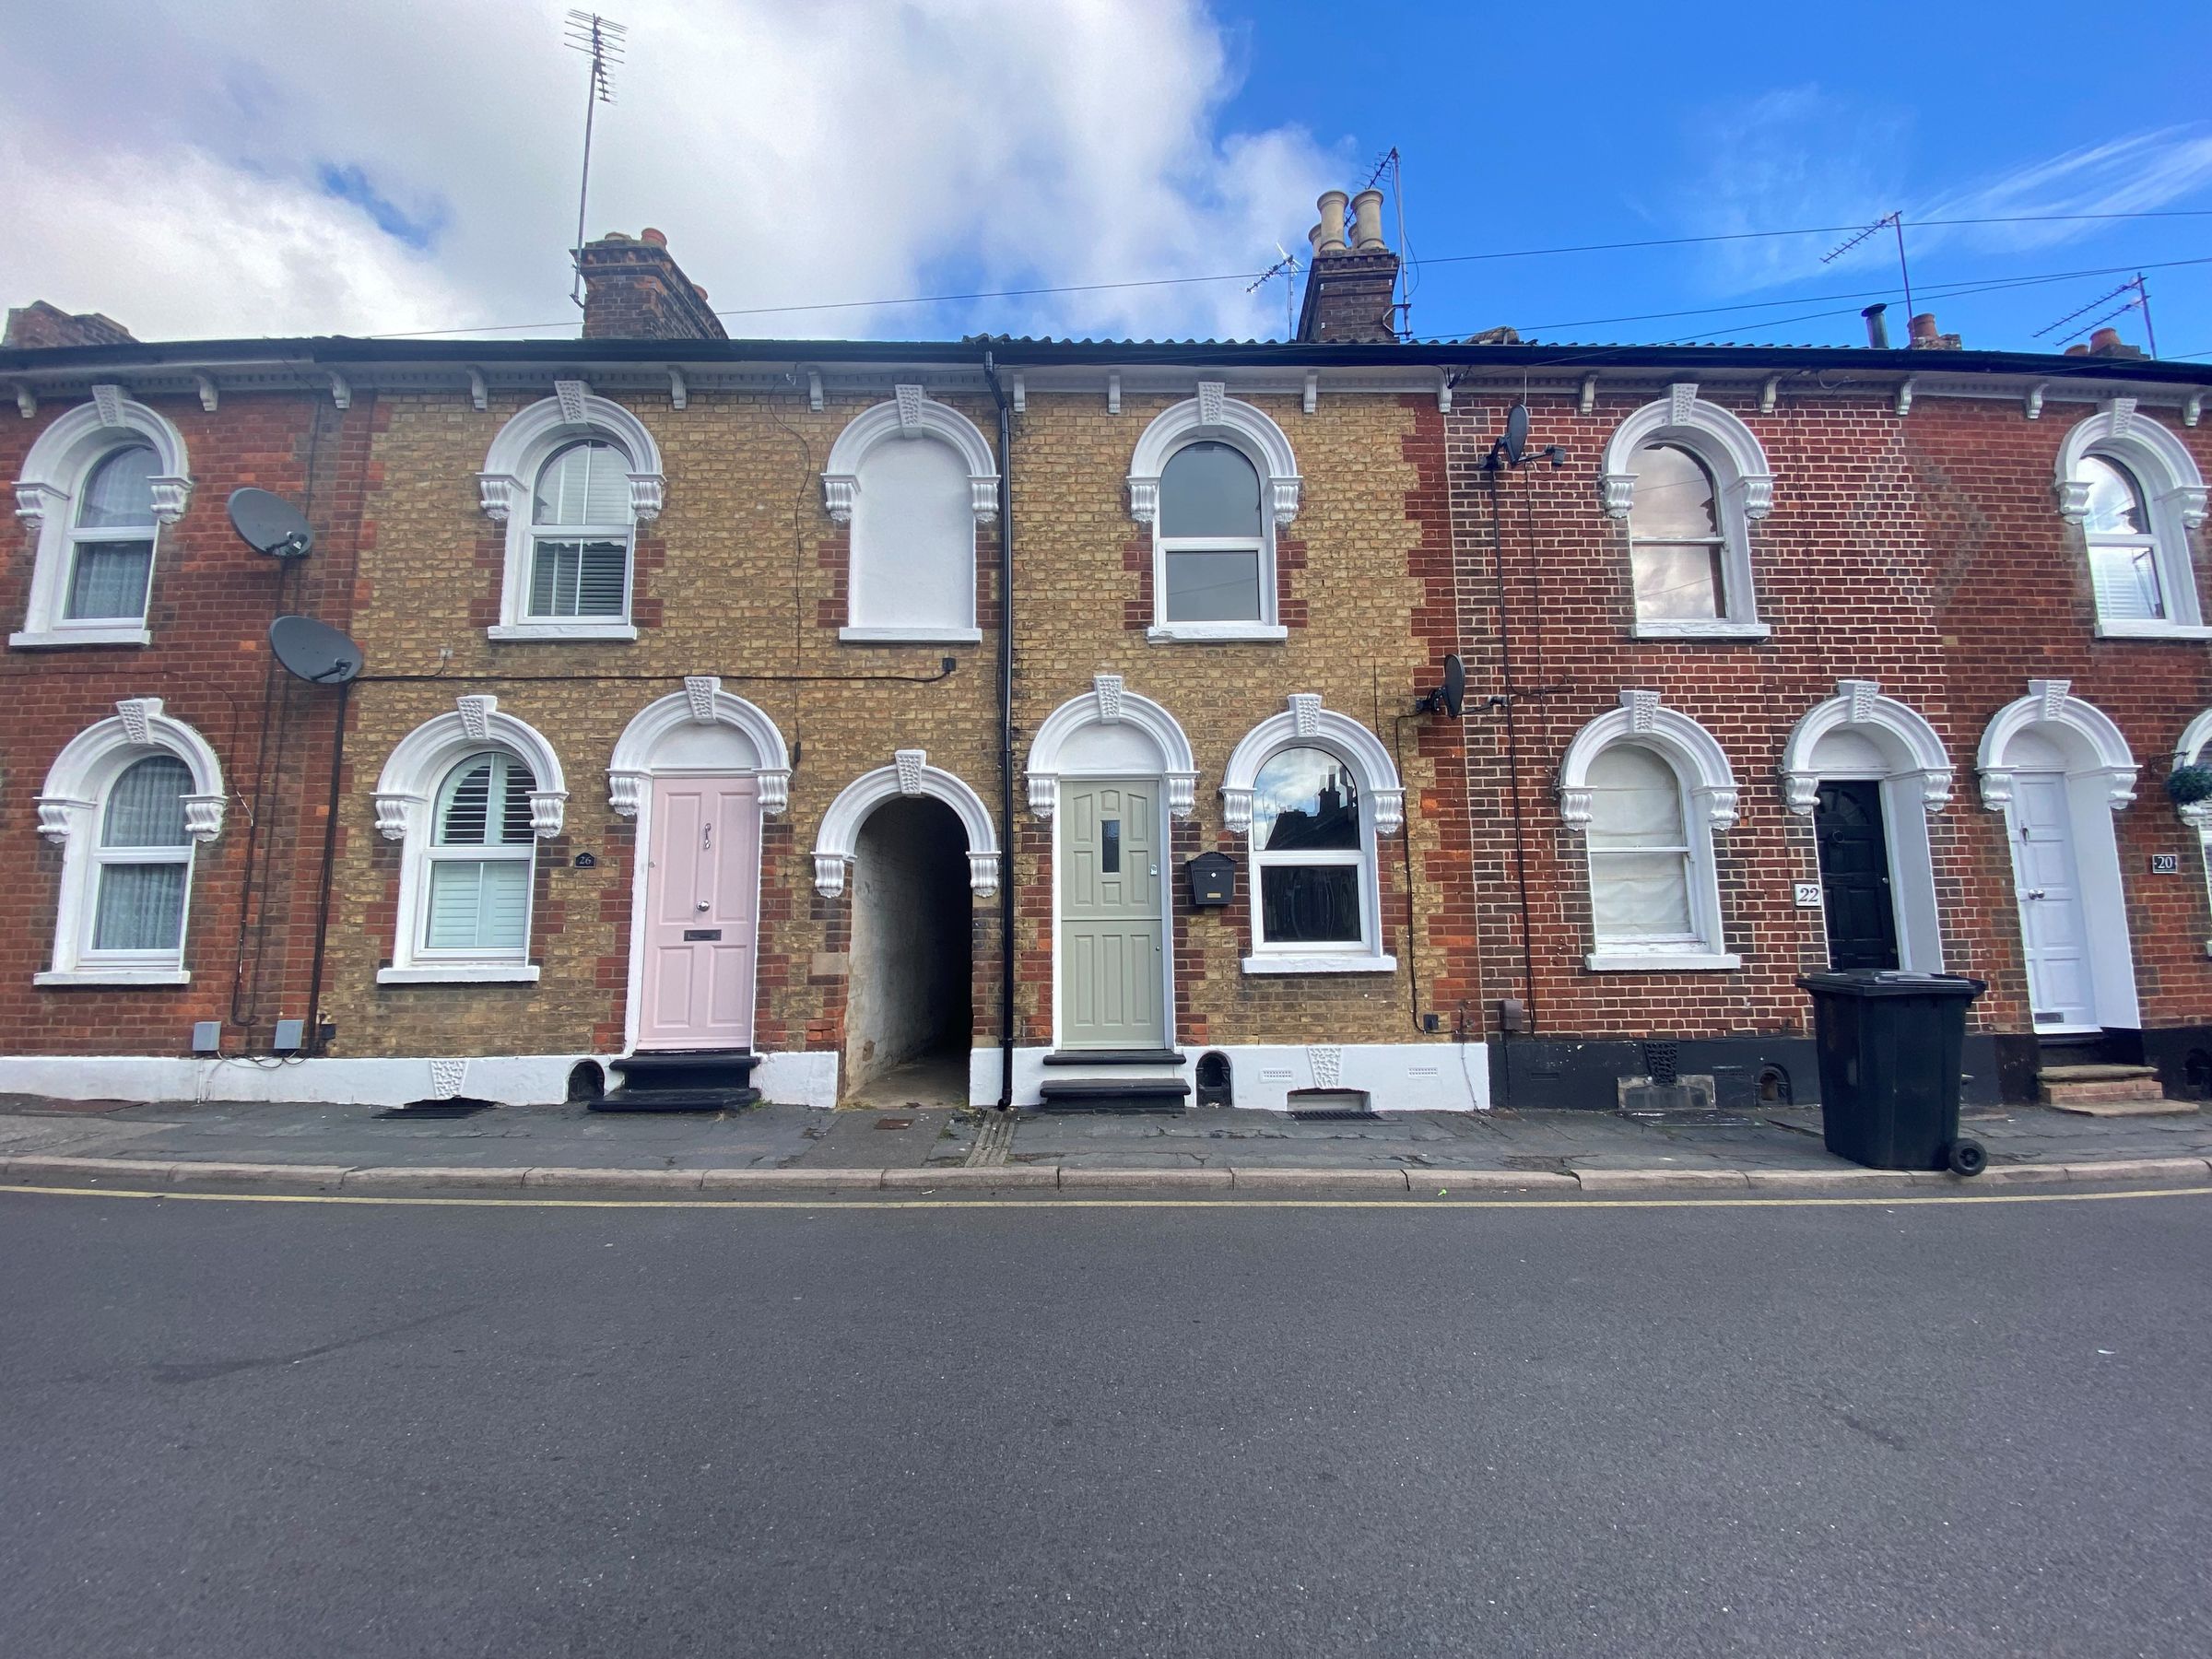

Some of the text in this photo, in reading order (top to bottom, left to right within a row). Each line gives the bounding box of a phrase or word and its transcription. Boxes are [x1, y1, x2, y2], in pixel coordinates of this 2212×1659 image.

[579, 856, 592, 865] 26
[2157, 856, 2173, 869] 20
[1797, 888, 1819, 902] 22
